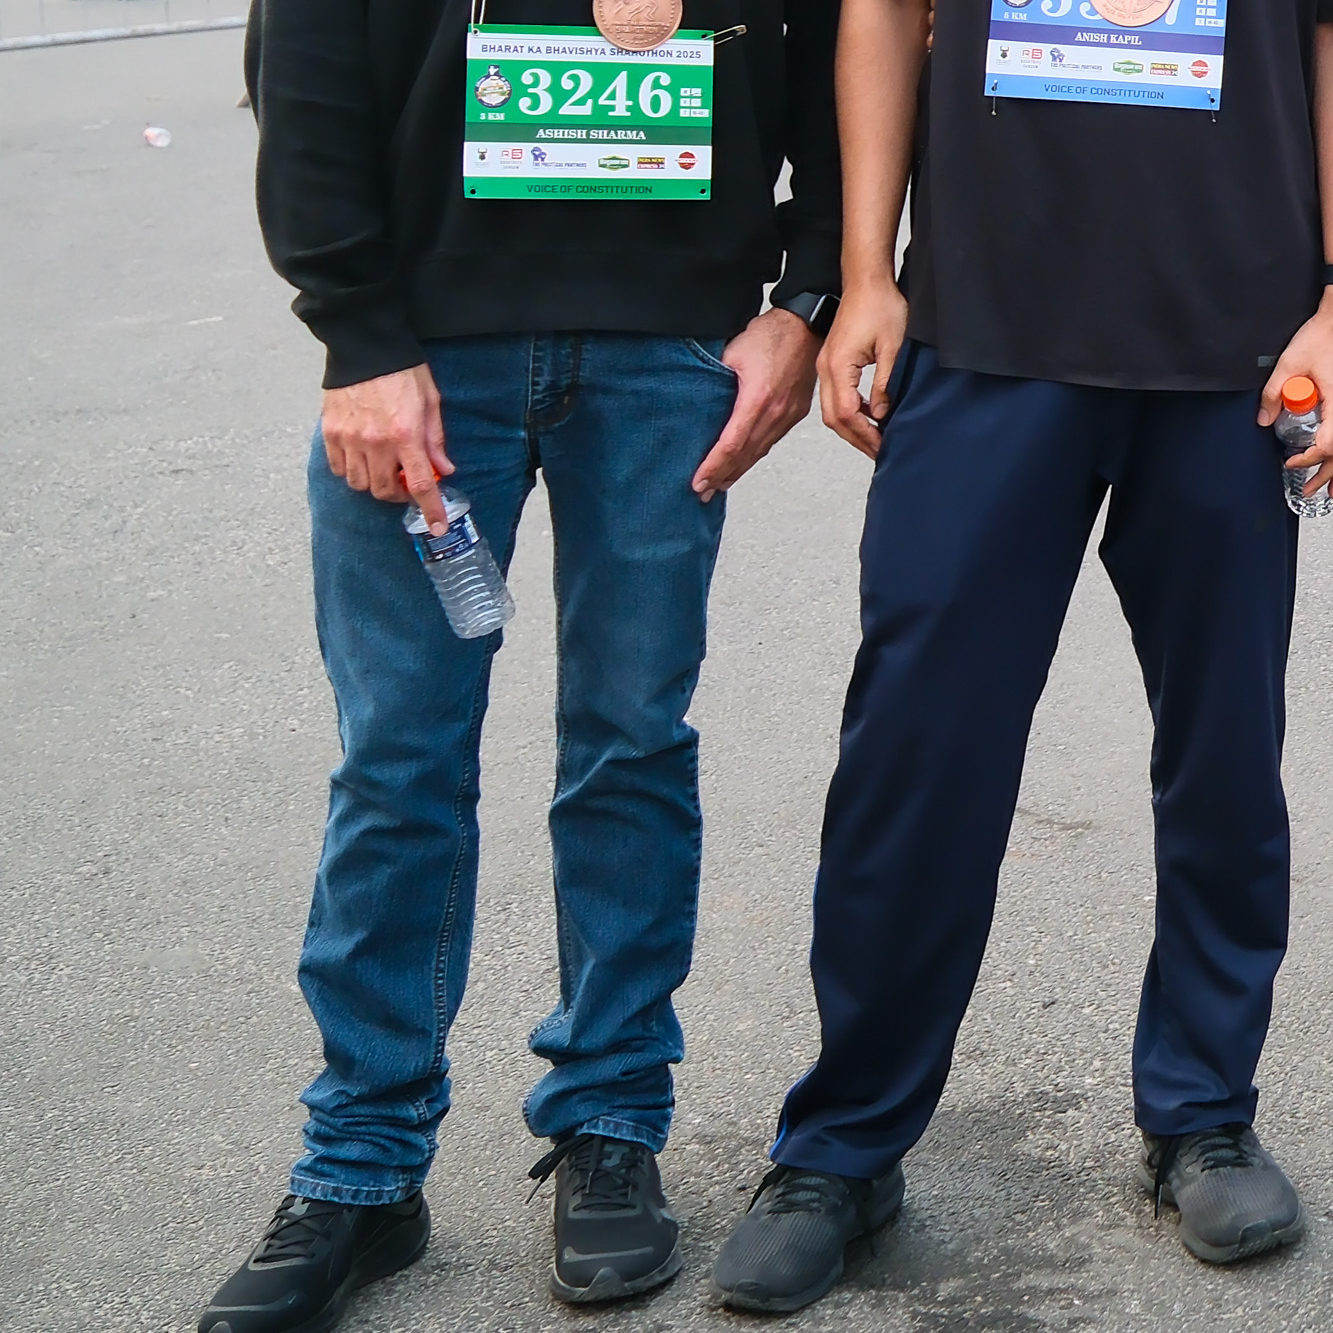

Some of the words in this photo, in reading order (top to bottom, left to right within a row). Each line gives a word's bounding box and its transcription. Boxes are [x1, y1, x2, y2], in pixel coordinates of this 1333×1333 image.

[1003, 11, 1010, 19] 5
[1011, 12, 1028, 20] KM
[1074, 31, 1109, 43] ANISH
[1109, 34, 1142, 45] KAPIL
[481, 44, 525, 55] BHARAT
[527, 46, 543, 55] KA
[545, 46, 607, 56] BHAVISHYA
[676, 50, 702, 59] 2025
[518, 67, 673, 118] 3246
[1044, 83, 1074, 94] VOICE
[1075, 86, 1088, 94] OF
[1090, 87, 1165, 99] CONSTITUTION
[480, 112, 486, 120] 3
[487, 112, 506, 120] KM
[535, 129, 588, 139] ASHISH
[589, 129, 647, 140] SHARMA
[526, 185, 559, 194] VOICE
[560, 185, 574, 194] OF
[575, 185, 653, 194] CONSTITUTION
